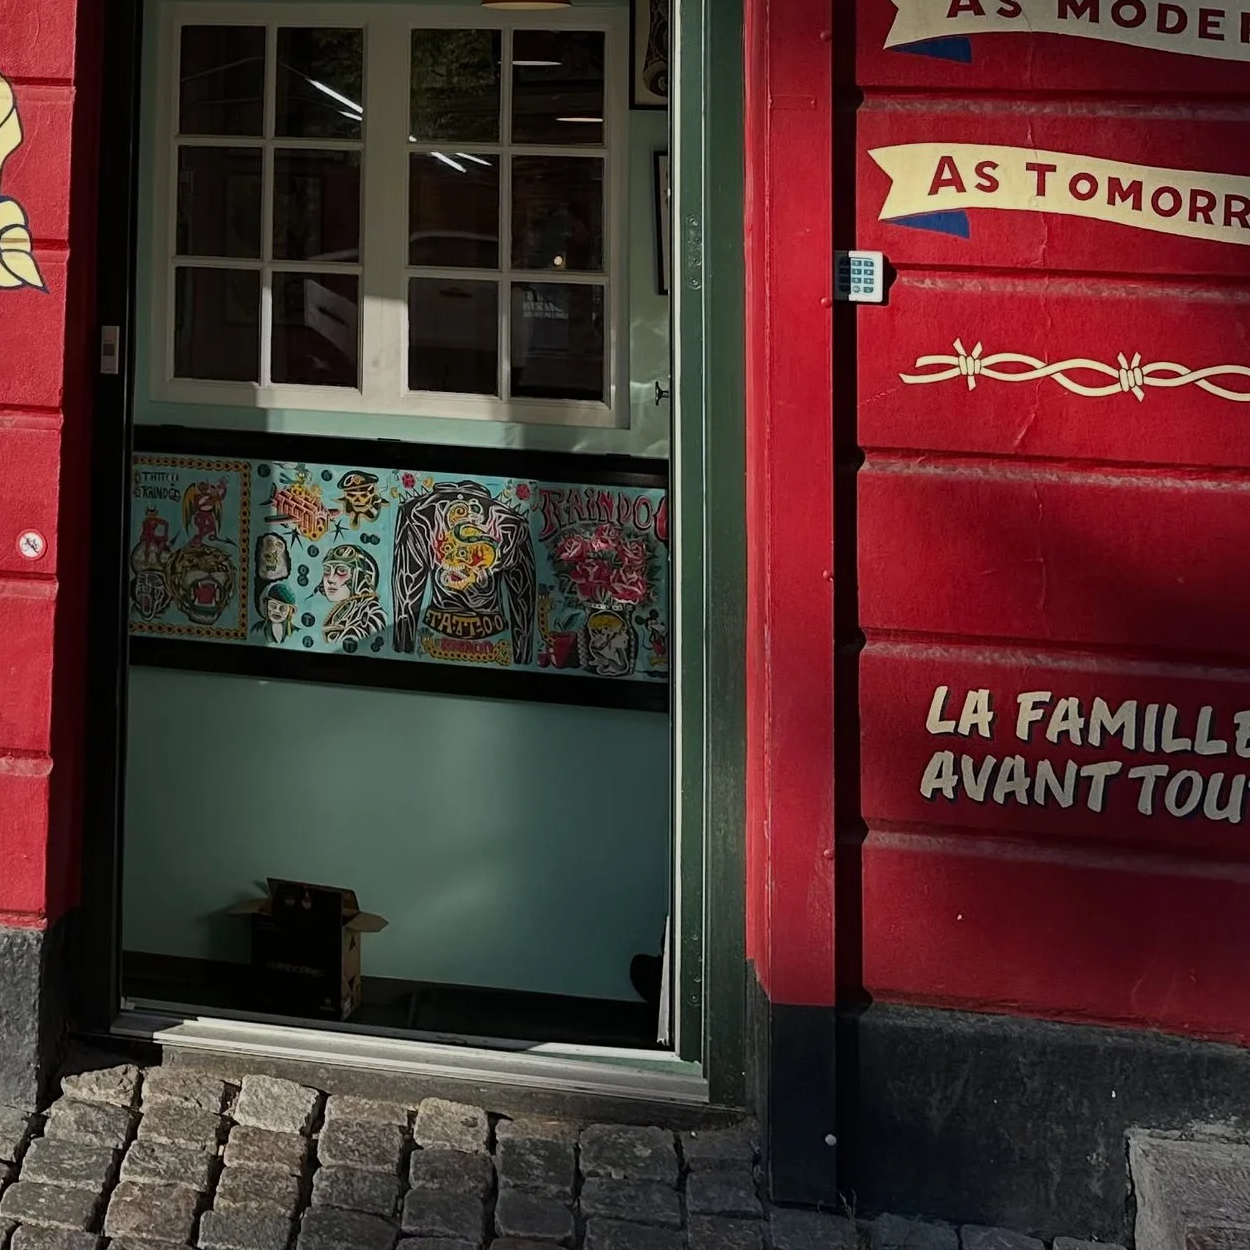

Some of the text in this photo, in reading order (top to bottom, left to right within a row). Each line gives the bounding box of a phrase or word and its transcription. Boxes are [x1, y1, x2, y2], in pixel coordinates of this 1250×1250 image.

[925, 685, 994, 739] LA
[919, 750, 1250, 824] AVANT TOU
